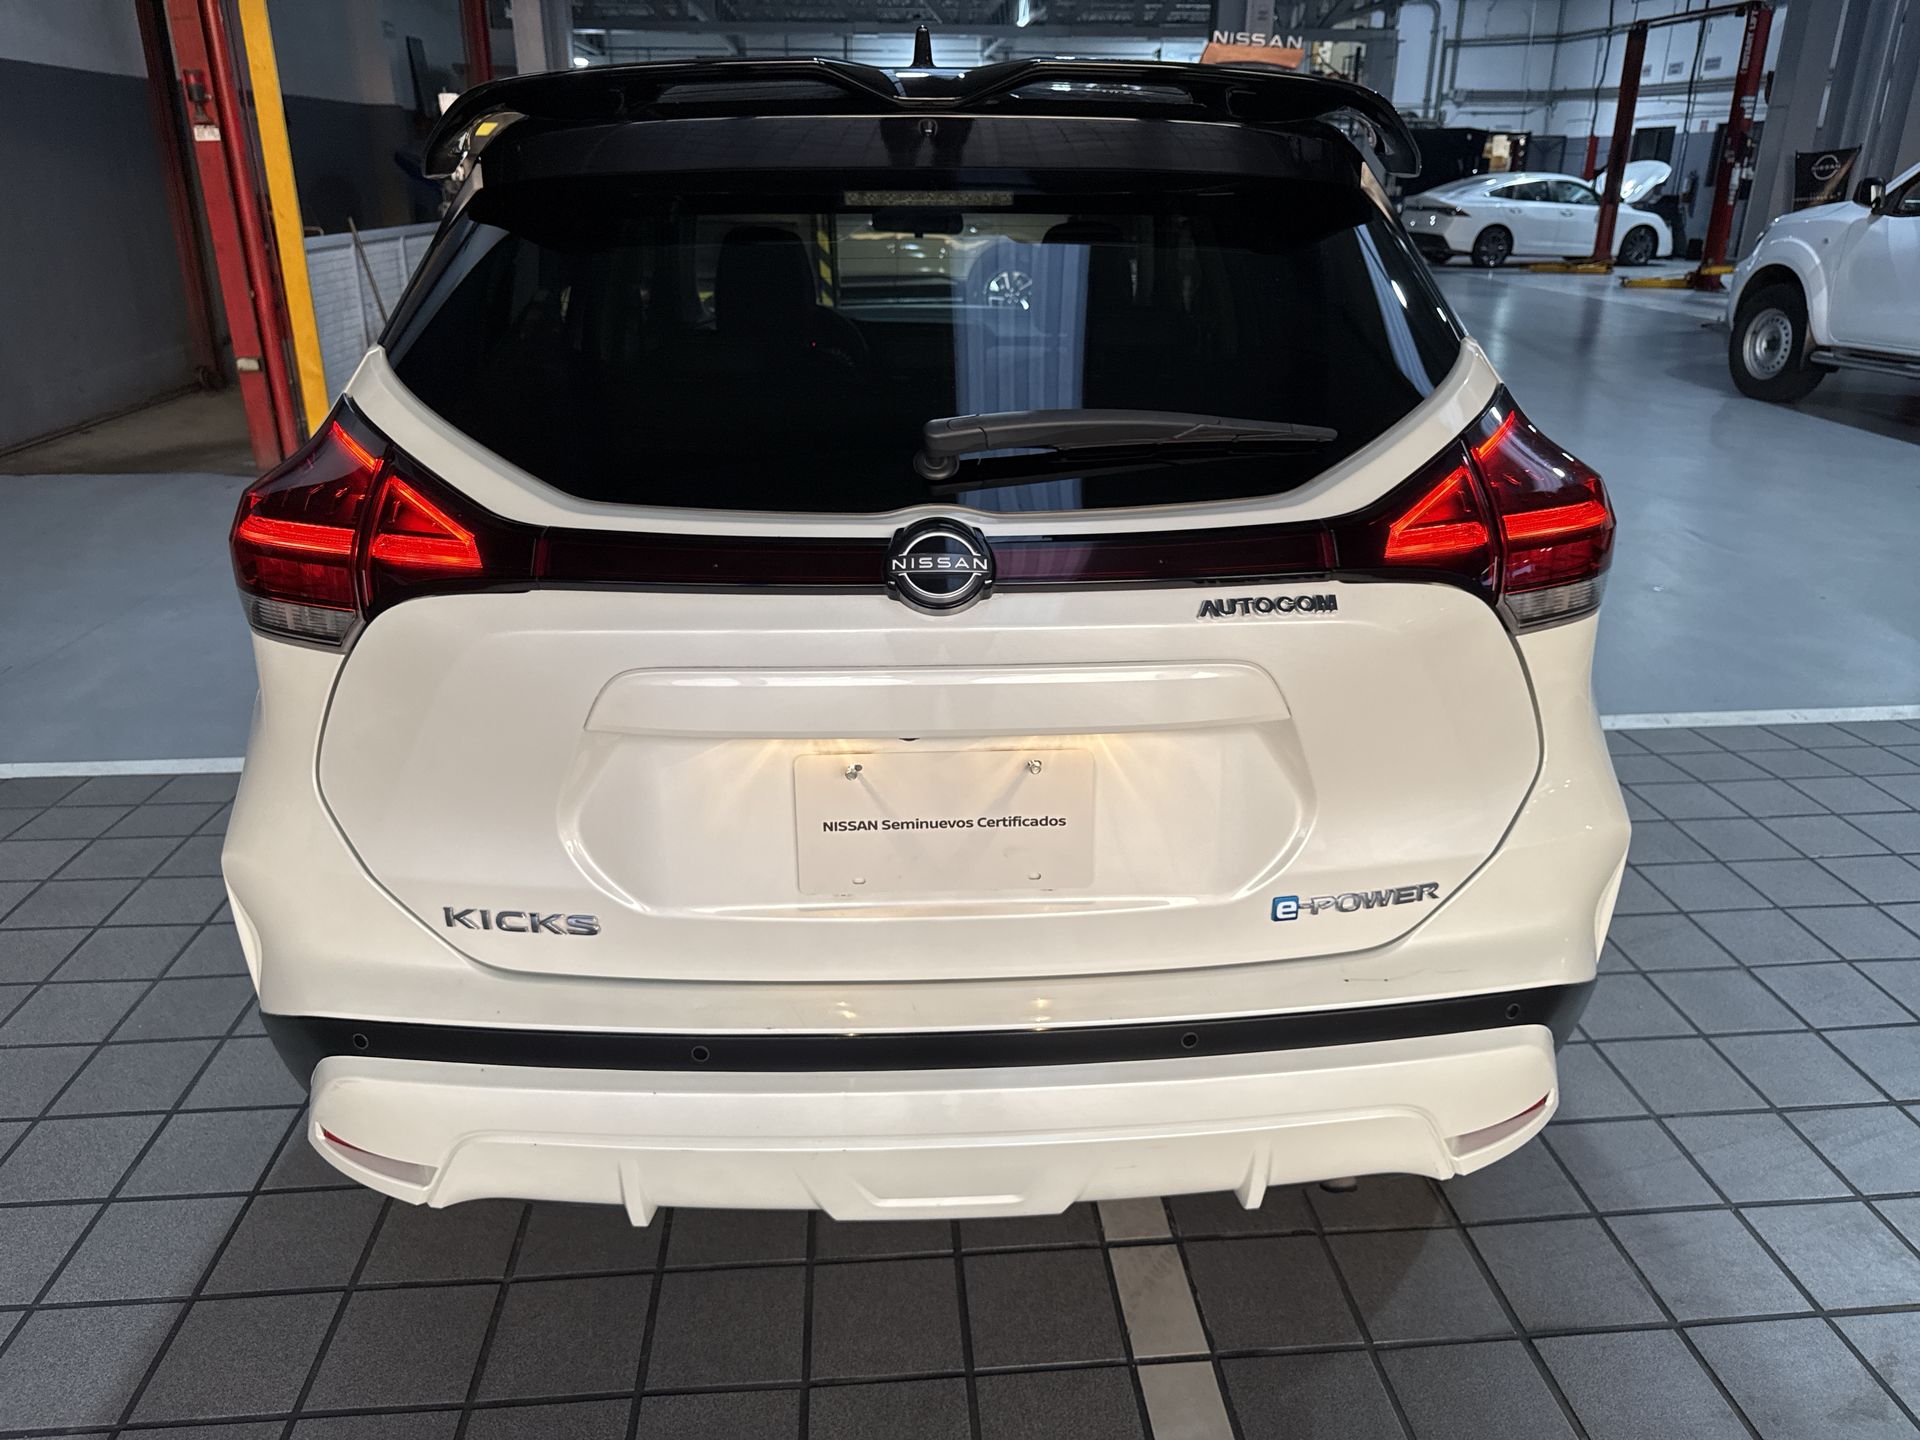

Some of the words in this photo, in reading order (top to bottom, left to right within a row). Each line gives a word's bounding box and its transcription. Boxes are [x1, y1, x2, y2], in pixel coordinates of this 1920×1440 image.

[1212, 29, 1304, 49] NISSAN
[892, 557, 988, 570] NISSAN
[1197, 594, 1338, 619] AUTOCOM
[823, 820, 878, 832] NISSAN
[881, 818, 974, 831] Seminuevos
[977, 816, 1067, 828] Certificados
[1271, 881, 1440, 922] e-POWER
[443, 906, 602, 936] KICKS
